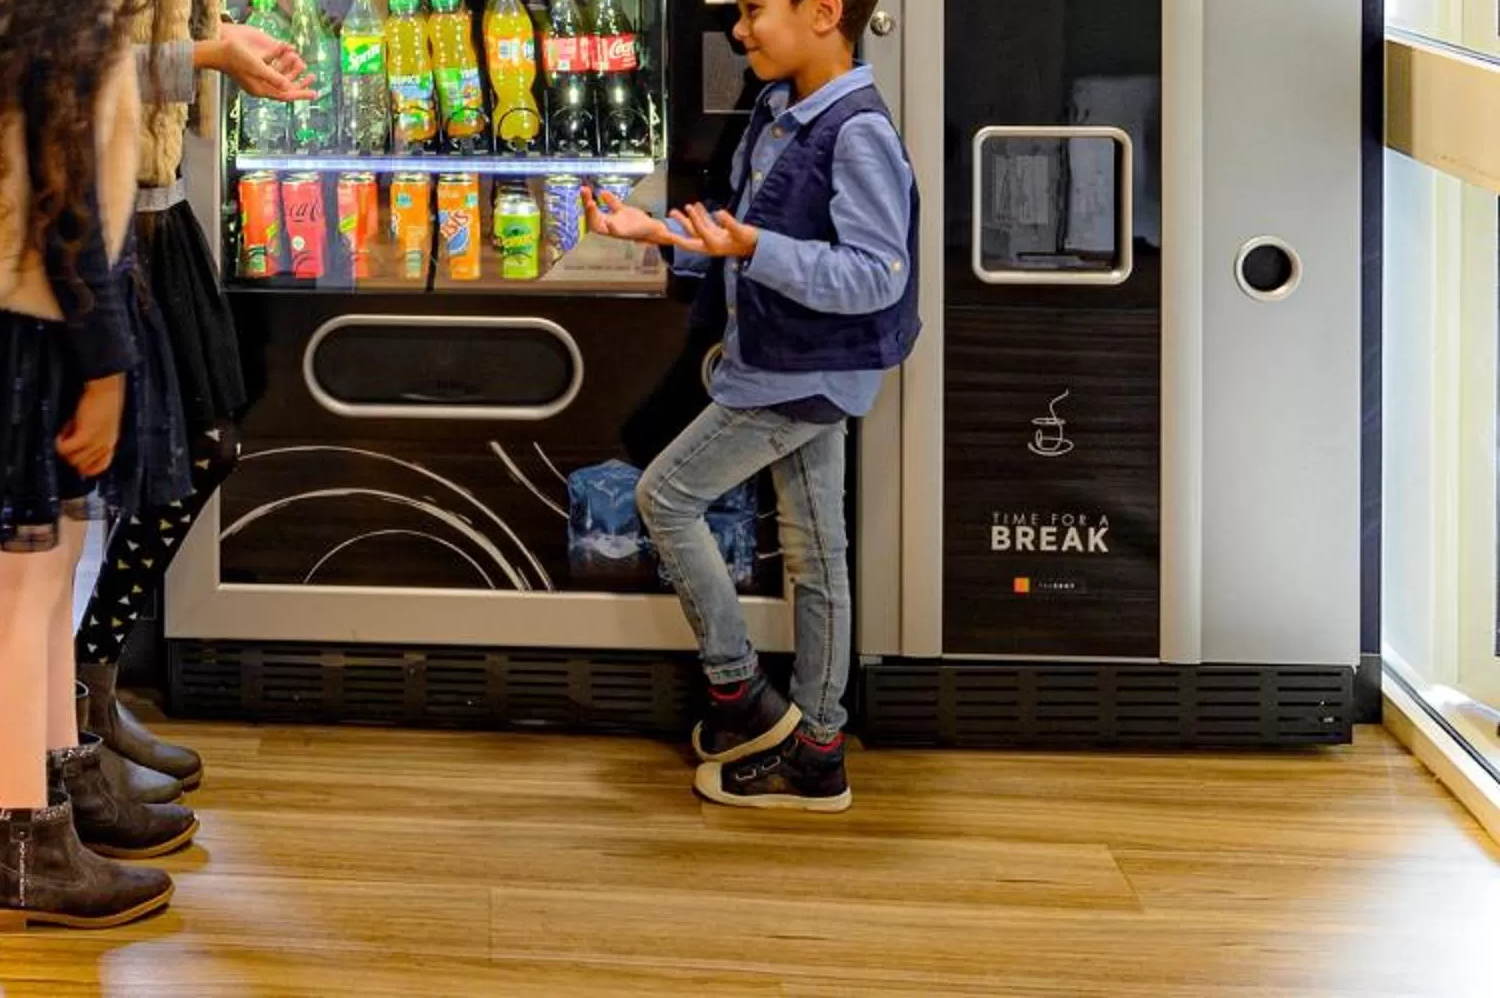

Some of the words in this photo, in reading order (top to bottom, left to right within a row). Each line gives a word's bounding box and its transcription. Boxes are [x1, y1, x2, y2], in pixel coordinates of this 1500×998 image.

[993, 513, 1040, 526] TIME
[1052, 513, 1087, 526] FOR
[1100, 514, 1109, 527] A
[990, 525, 1110, 553] BREAK
